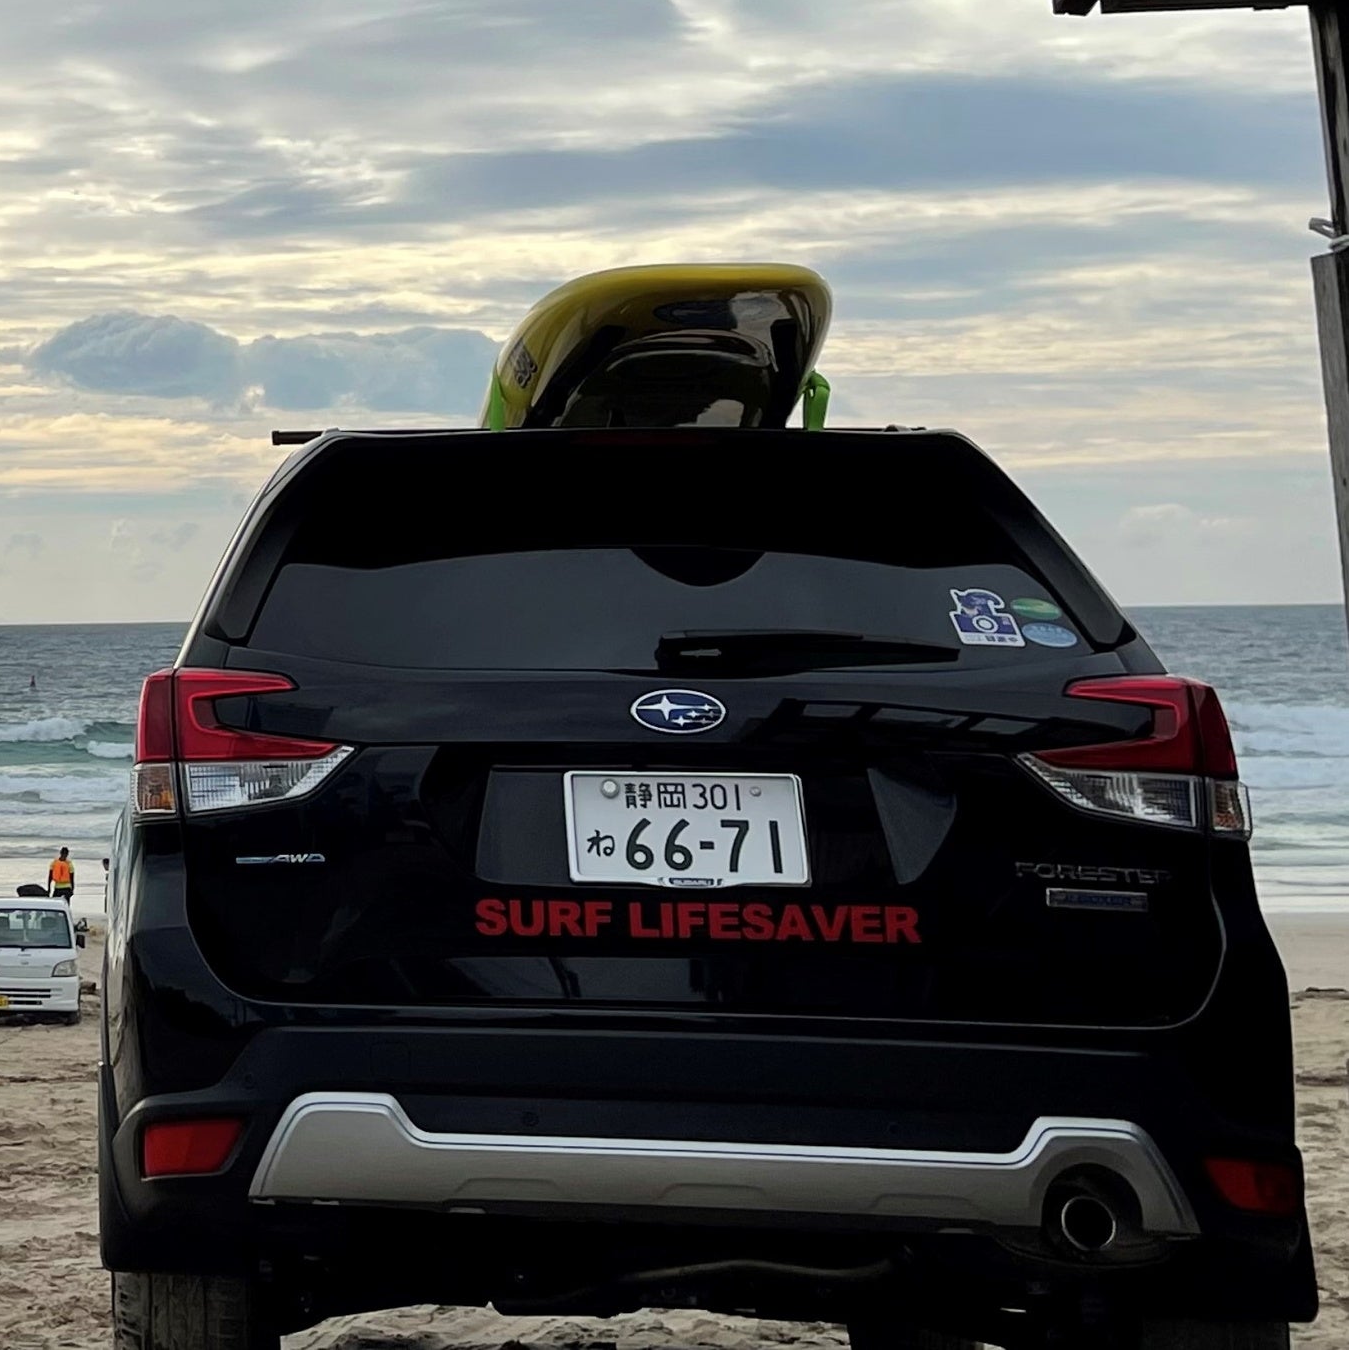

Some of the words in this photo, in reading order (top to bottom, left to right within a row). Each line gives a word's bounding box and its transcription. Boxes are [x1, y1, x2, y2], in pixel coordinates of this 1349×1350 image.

[272, 853, 326, 863] AWD
[586, 829, 616, 857] ね
[626, 817, 783, 874] 66-71
[475, 899, 612, 937] SURF
[629, 902, 921, 943] LIFESAVER
